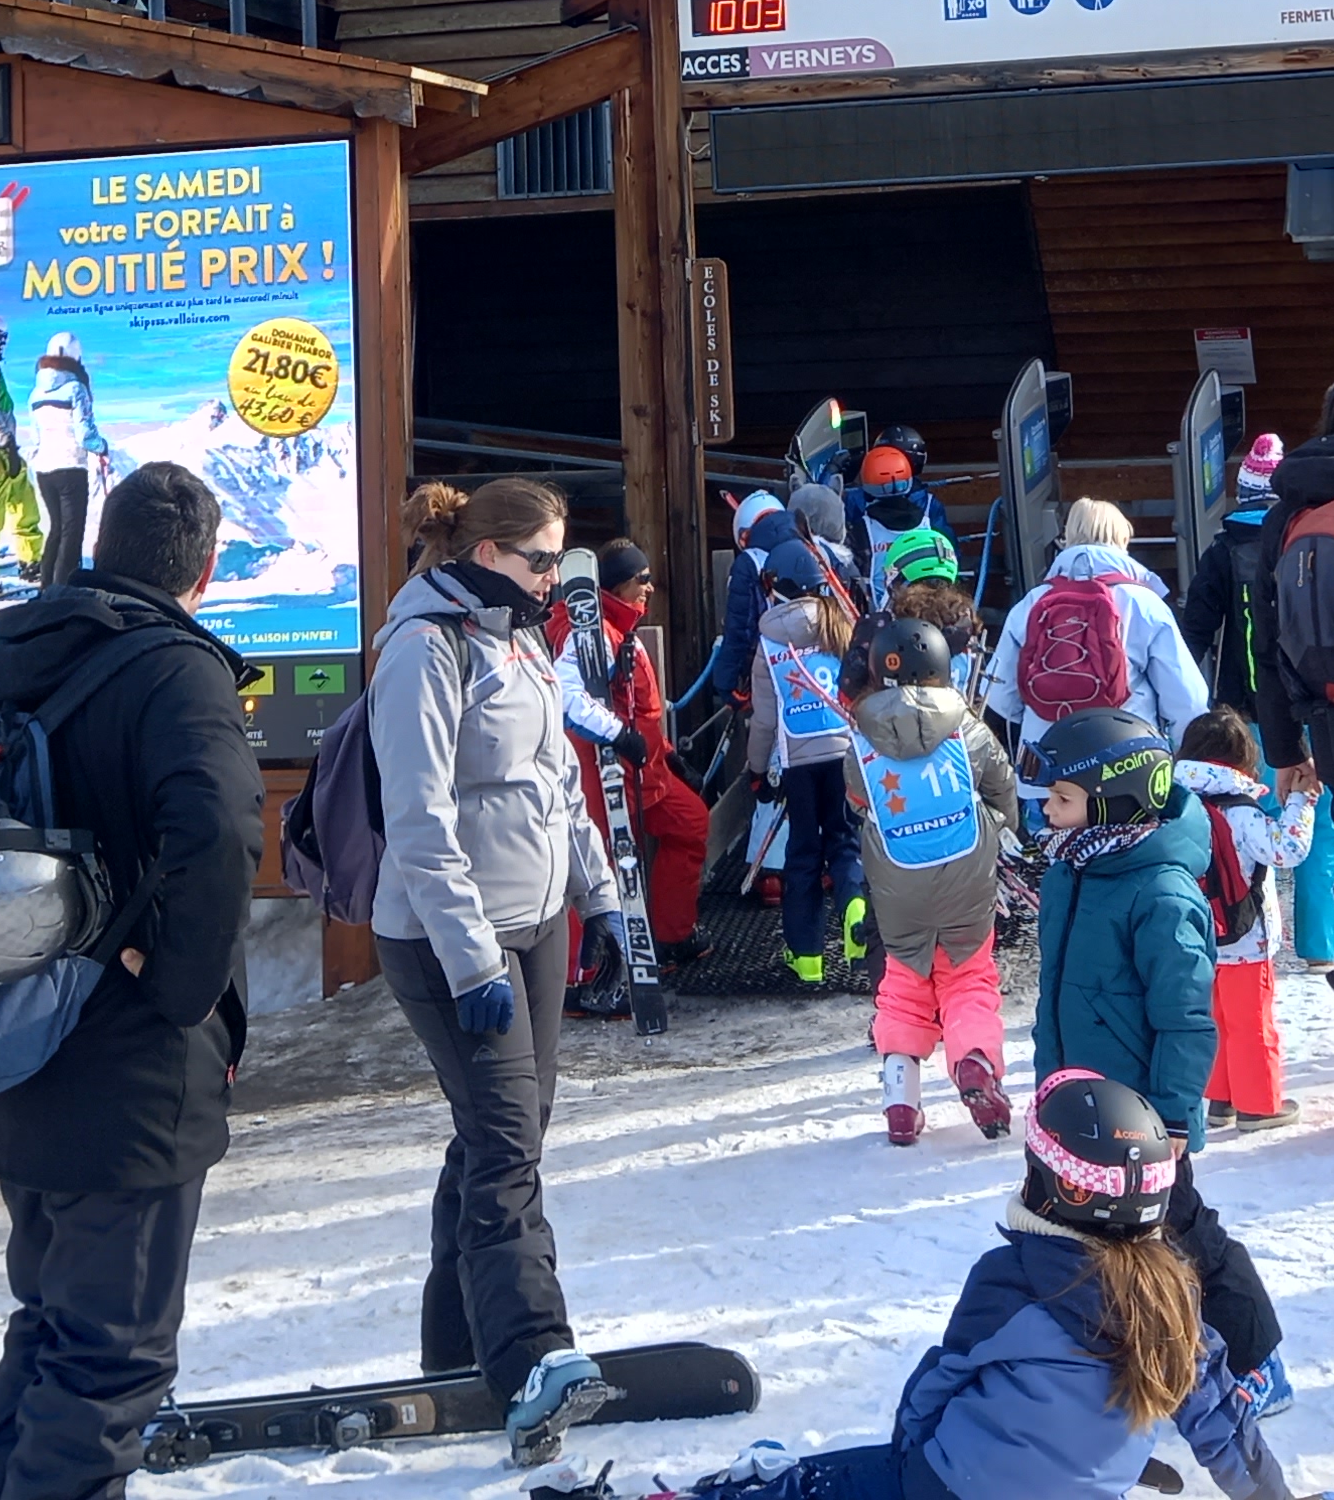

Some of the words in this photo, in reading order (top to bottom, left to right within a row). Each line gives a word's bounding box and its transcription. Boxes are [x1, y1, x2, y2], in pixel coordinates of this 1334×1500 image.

[682, 54, 741, 76] ACCES
[761, 45, 876, 70] VERNEYS
[92, 176, 127, 205] LE
[135, 166, 260, 202] SAMEDI
[59, 221, 126, 245] votre
[135, 204, 273, 240] FORFAIT
[280, 203, 294, 230] à
[23, 239, 186, 299] MOITIÉ
[202, 242, 309, 288] PRIX
[94, 304, 113, 316] ligne
[205, 297, 222, 306] tard
[703, 266, 716, 351] ECOLES
[251, 333, 292, 350] GALIBIER
[295, 343, 332, 360] THABOR
[272, 328, 317, 346] DOMAINE
[242, 347, 332, 389] 21,80€
[707, 359, 719, 387] DE
[709, 394, 722, 437] SKI
[237, 634, 250, 644] LA
[252, 632, 290, 643] SAISON
[292, 631, 332, 642] D'HIVER
[245, 713, 254, 727] 2
[790, 701, 829, 715] MOUL
[1062, 756, 1099, 775] LUGIK
[1114, 750, 1154, 775] cairn
[921, 759, 960, 797] 11
[892, 812, 966, 837] VERNEYS
[1122, 1130, 1148, 1141] cairn
